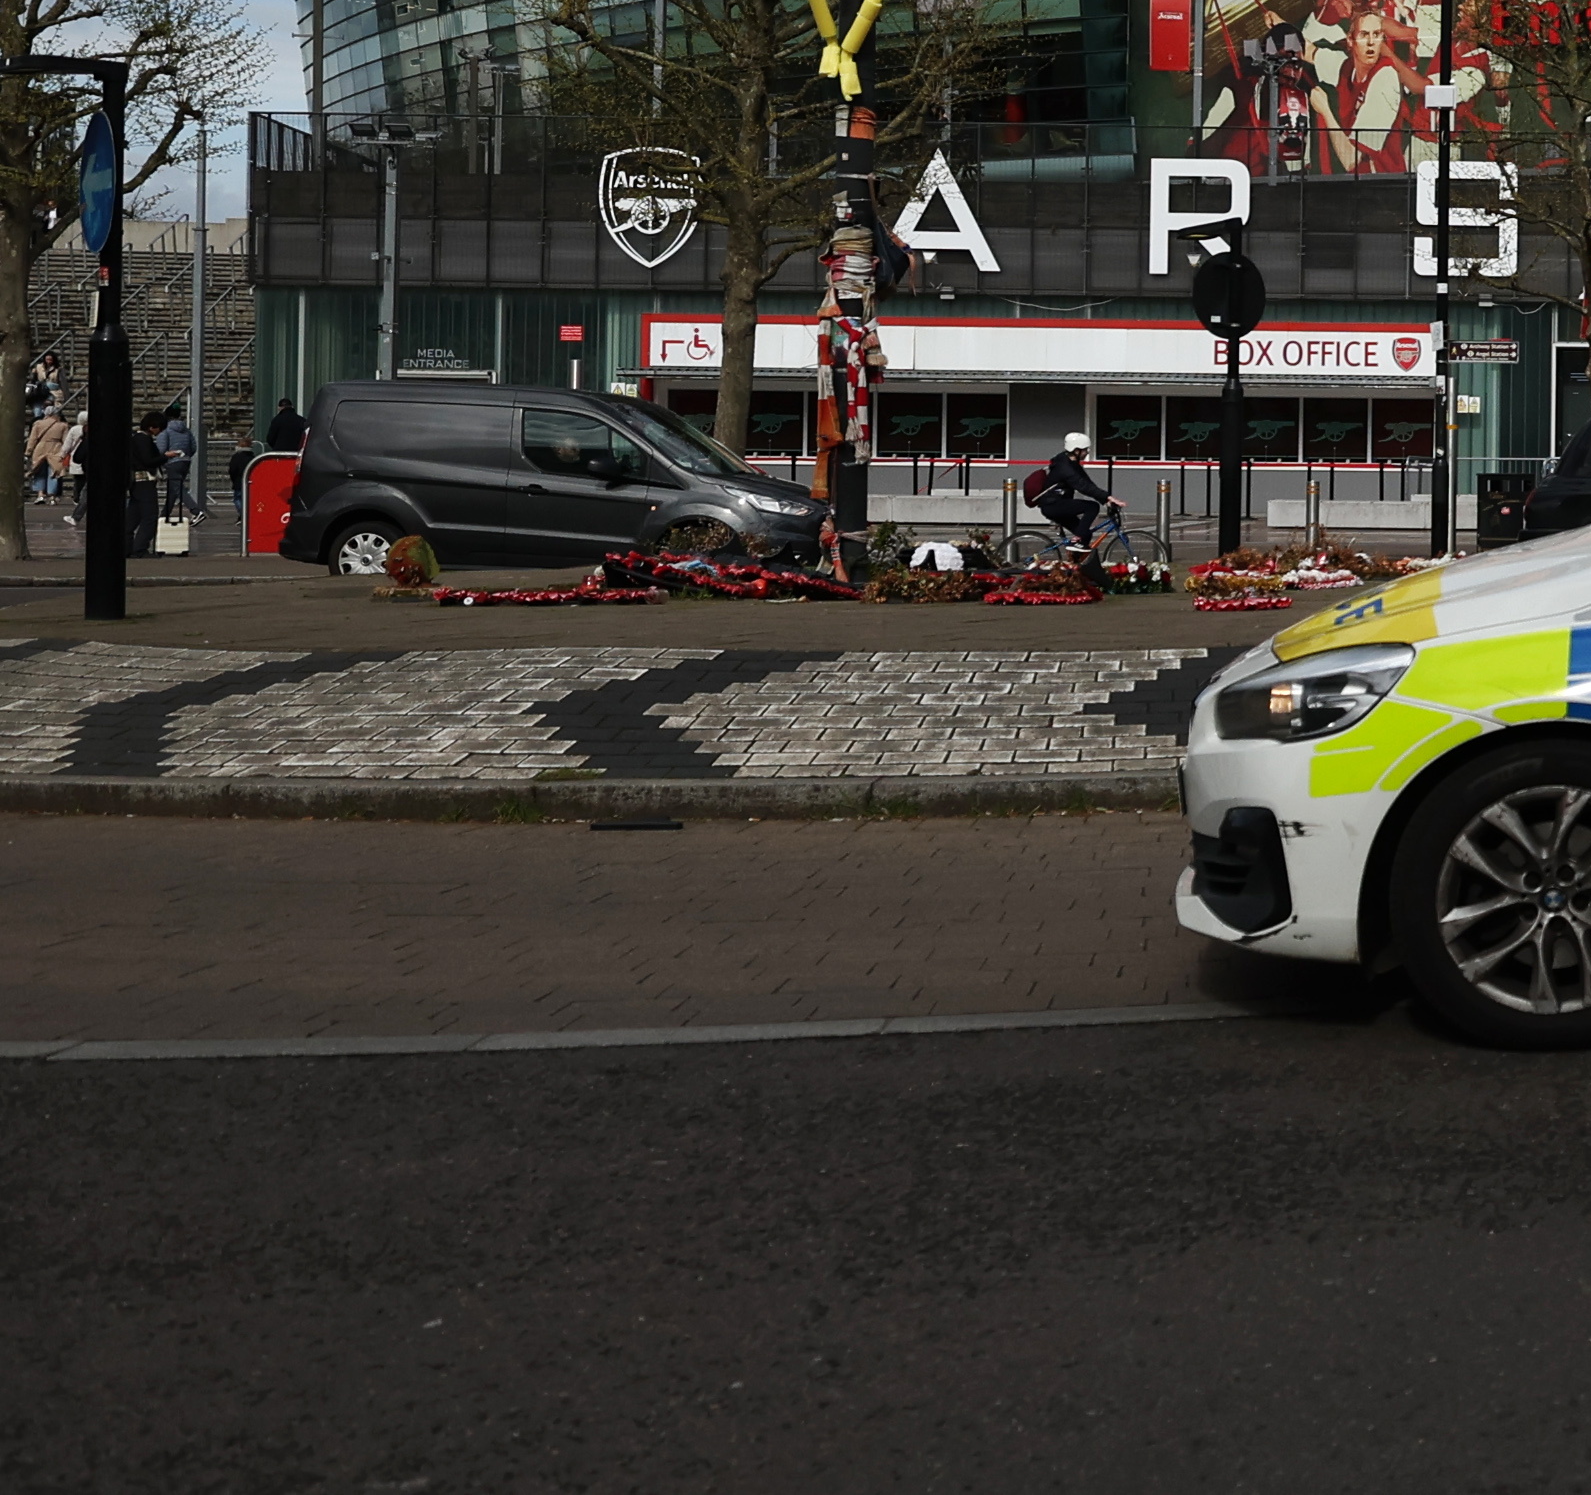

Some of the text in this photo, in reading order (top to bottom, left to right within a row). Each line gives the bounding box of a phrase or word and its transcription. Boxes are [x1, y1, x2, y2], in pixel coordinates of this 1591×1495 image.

[417, 348, 455, 358] MEDIA
[1213, 339, 1379, 367] BOX OFFICE
[402, 358, 470, 370] ENTRANCE
